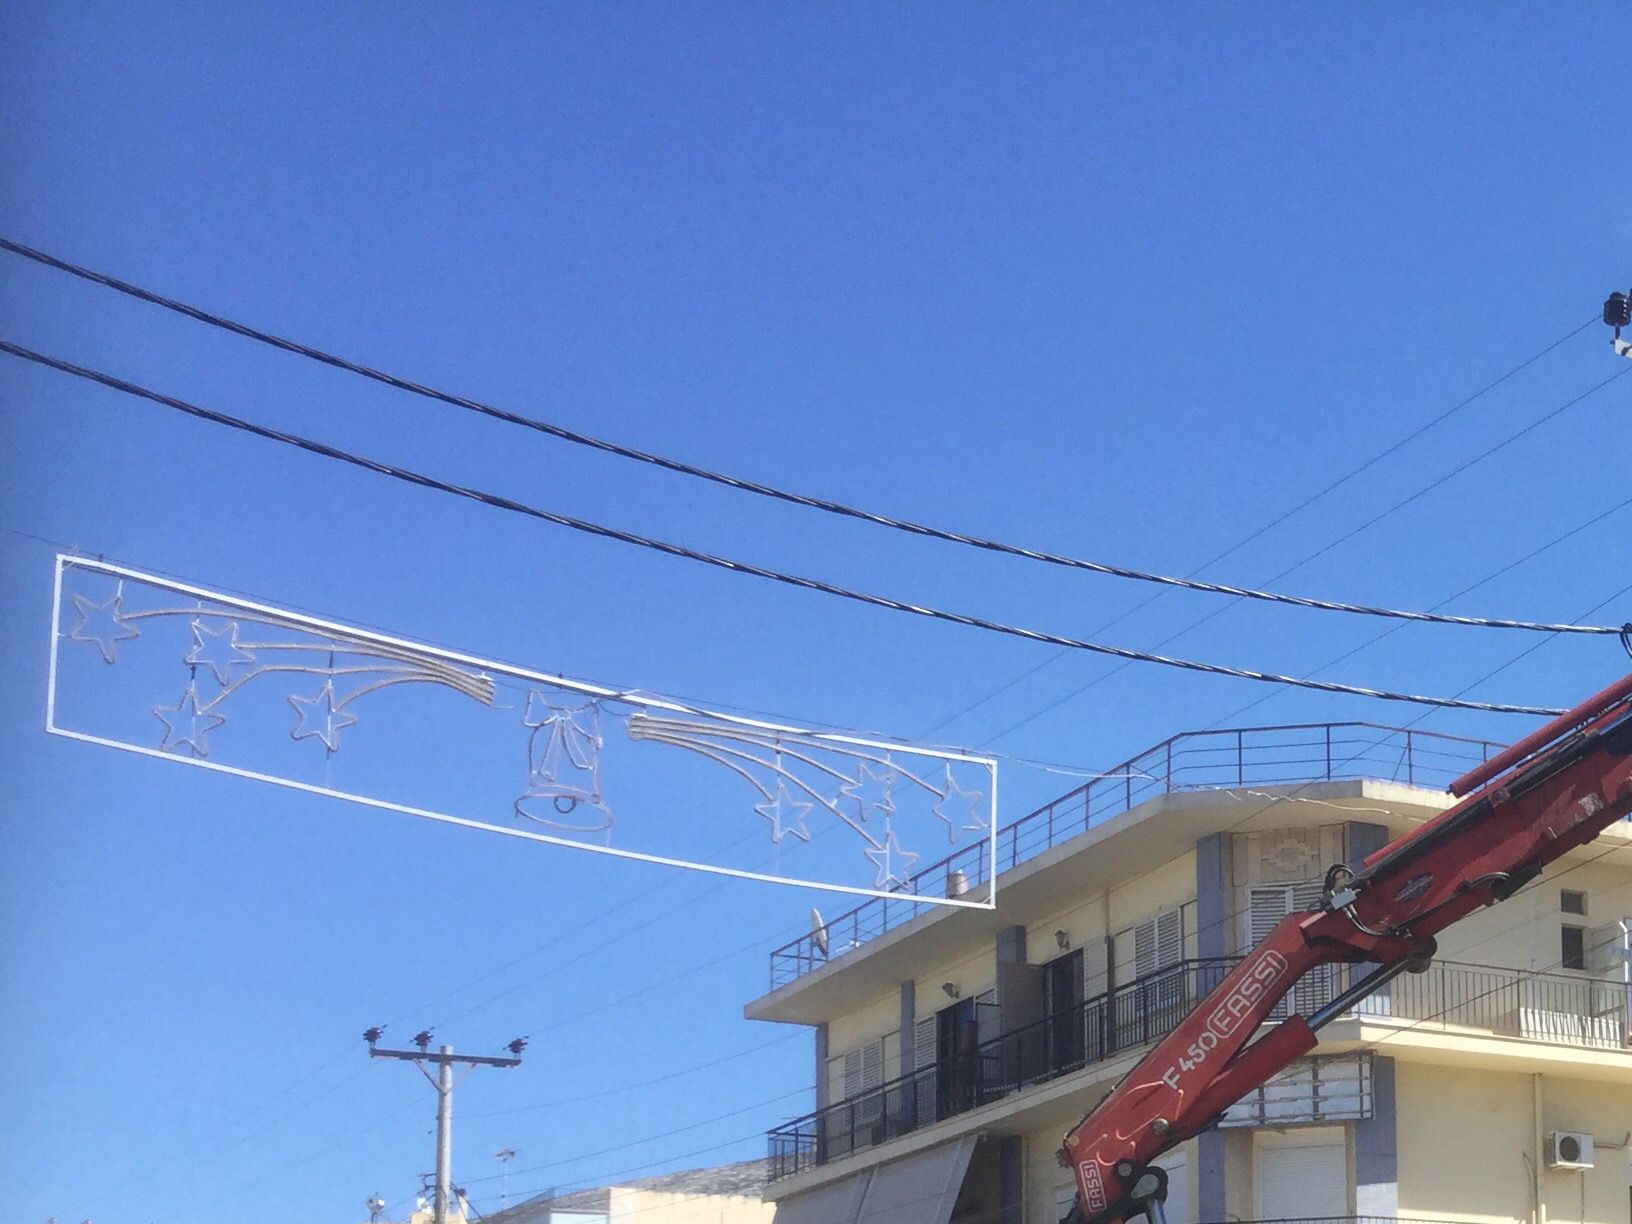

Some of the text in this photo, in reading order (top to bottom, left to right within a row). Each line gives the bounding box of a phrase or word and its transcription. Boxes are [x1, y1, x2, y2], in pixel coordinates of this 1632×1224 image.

[1178, 1031, 1218, 1072] 450
[1213, 956, 1282, 1033] FASSI
[1083, 1163, 1103, 1208] FASSI
